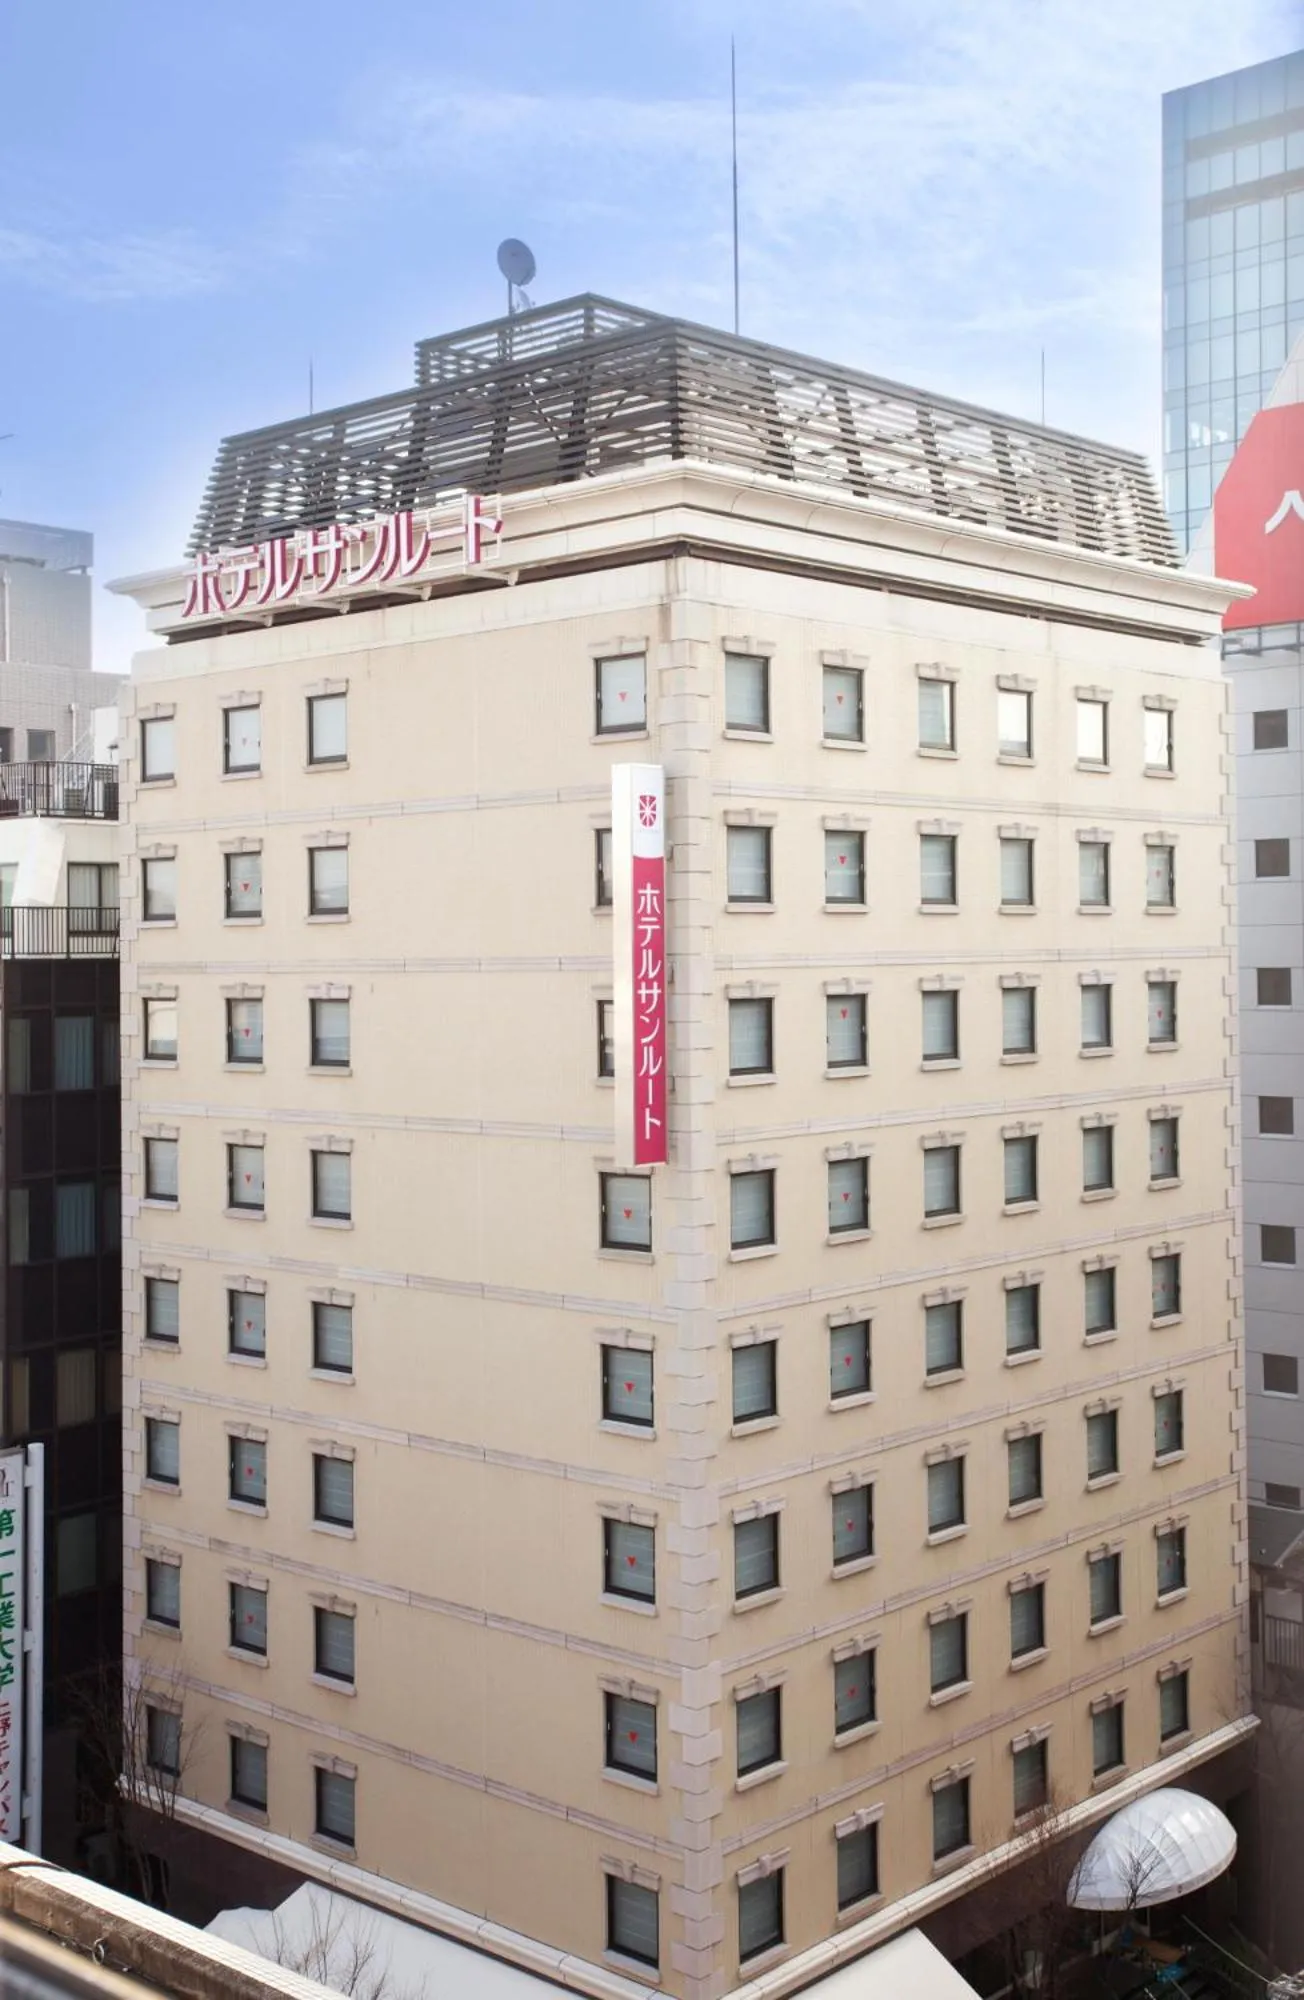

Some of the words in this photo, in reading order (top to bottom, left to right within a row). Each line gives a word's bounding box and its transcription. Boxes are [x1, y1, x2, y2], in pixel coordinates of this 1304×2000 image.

[182, 495, 503, 617] ホテルサンルート
[637, 882, 662, 1140] ホテルサンルート
